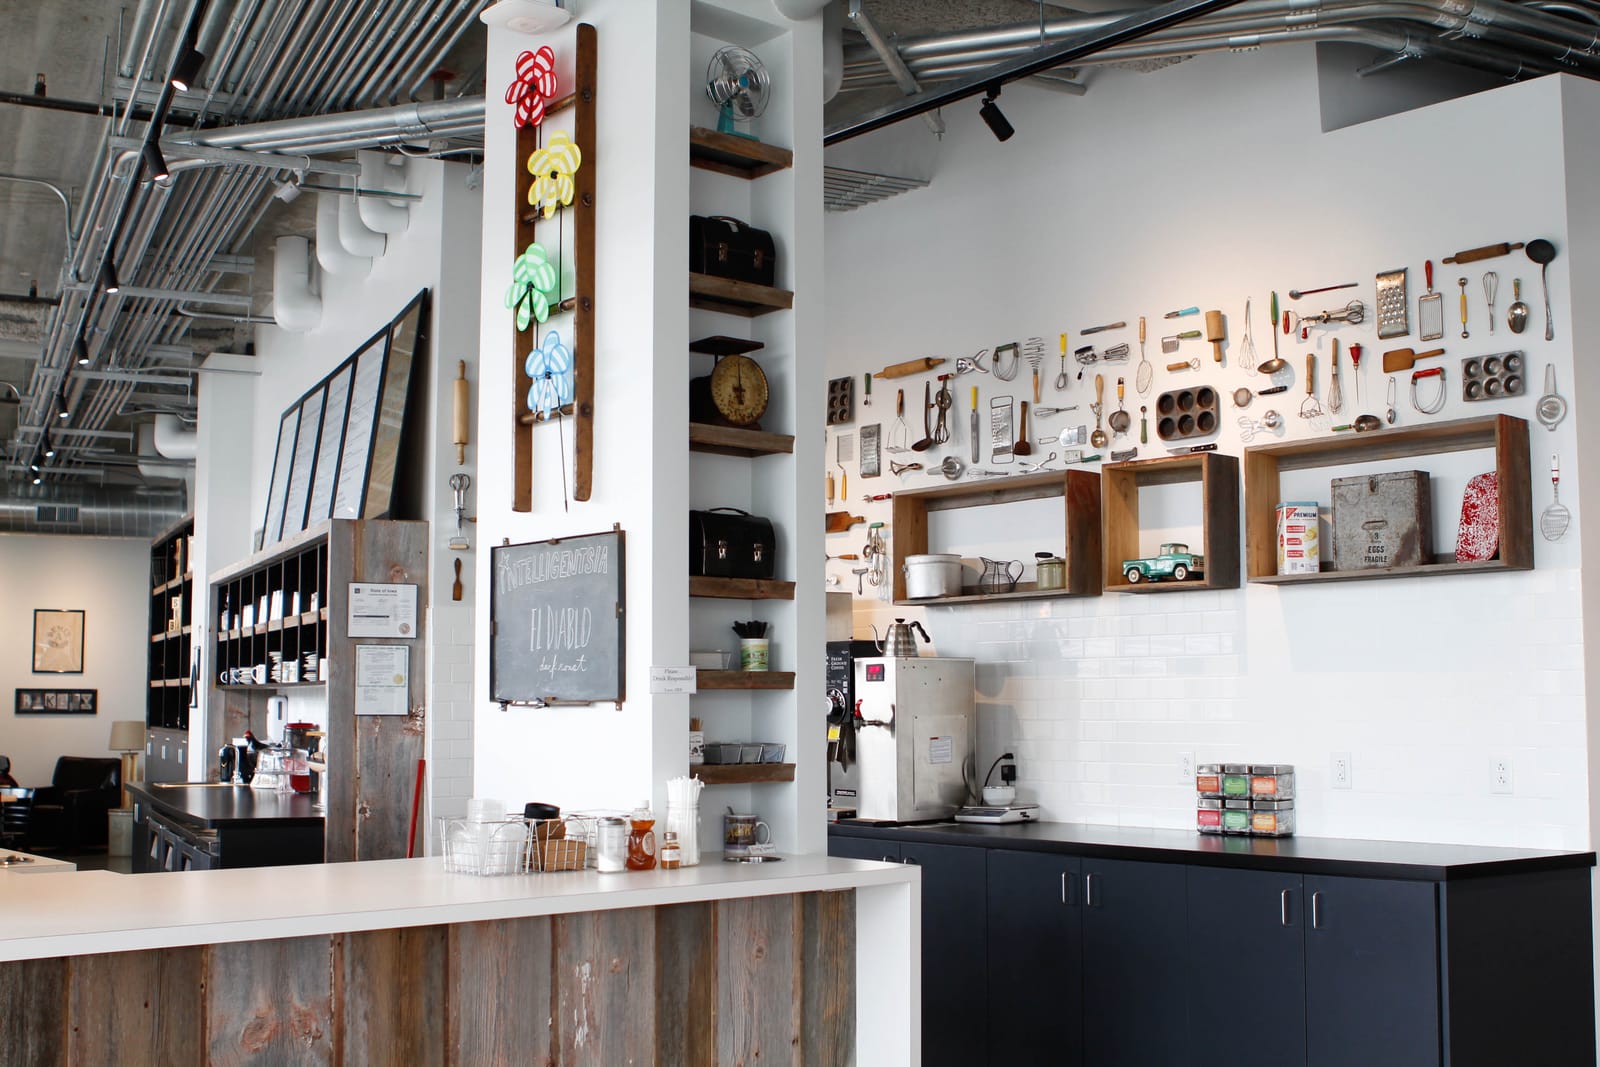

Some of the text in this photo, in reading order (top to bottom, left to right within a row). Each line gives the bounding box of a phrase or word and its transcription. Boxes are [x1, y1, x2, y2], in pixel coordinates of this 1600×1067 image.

[1364, 555, 1388, 563] FRAGILE
[1367, 545, 1385, 554] EGGS
[498, 546, 608, 595] INTELLIGENTSIA
[546, 605, 592, 651] DIABLO
